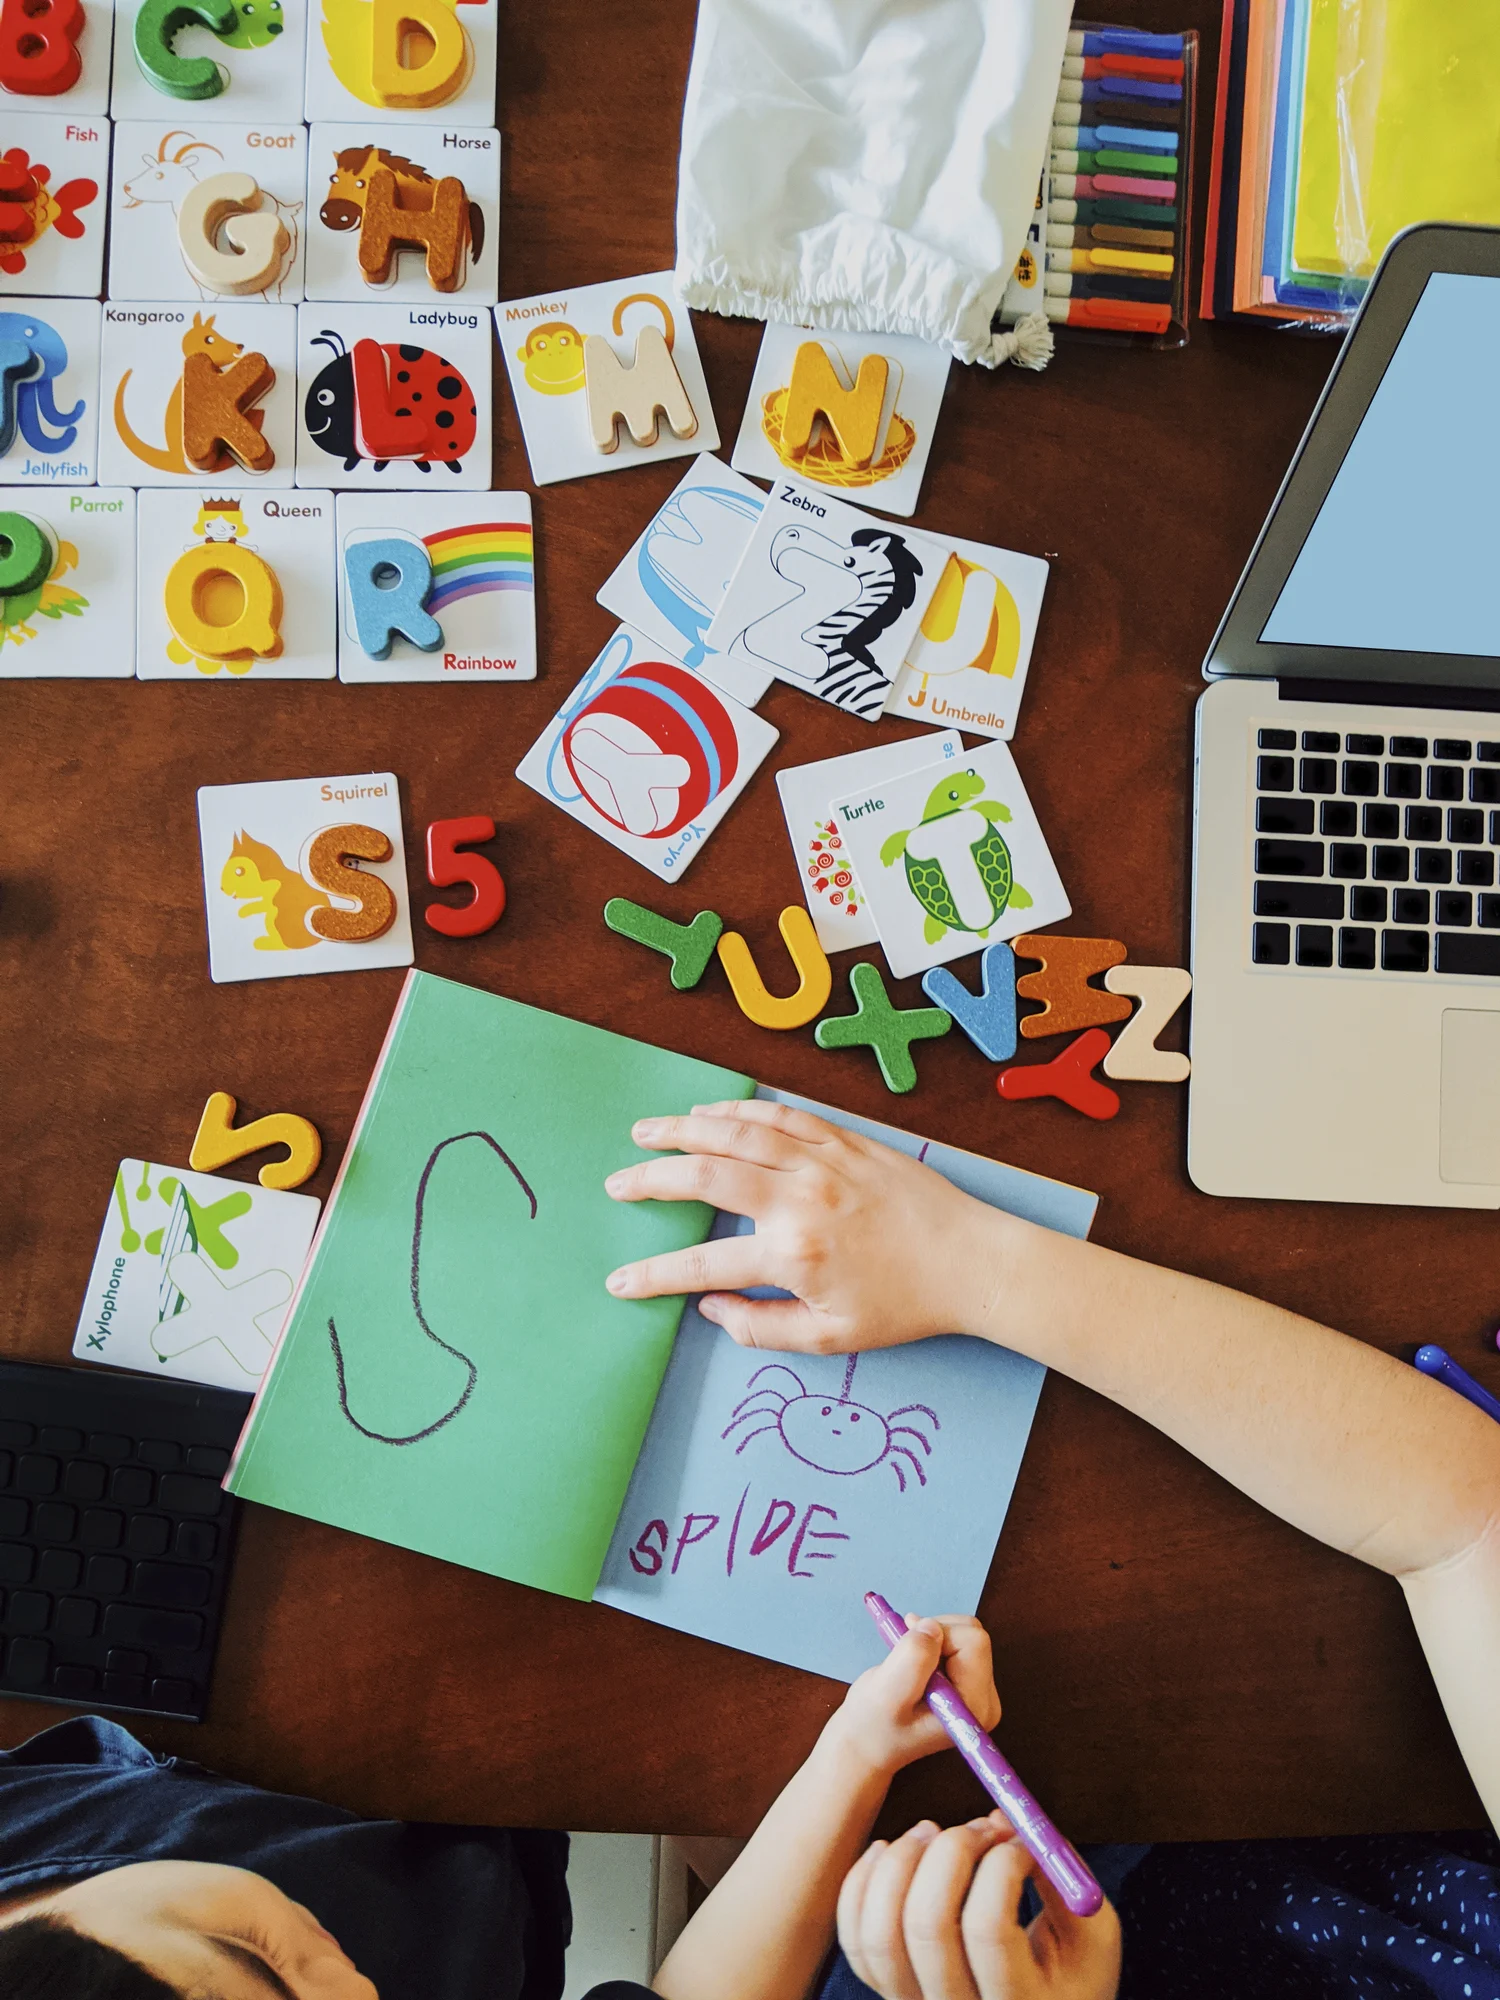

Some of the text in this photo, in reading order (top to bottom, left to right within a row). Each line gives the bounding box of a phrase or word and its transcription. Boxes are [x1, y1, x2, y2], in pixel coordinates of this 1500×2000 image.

[66, 126, 98, 142] Fish
[246, 132, 296, 149] Goat
[443, 132, 492, 150] Horse
[105, 309, 185, 326] Kangaroo
[409, 310, 478, 328] Ladybug
[505, 301, 569, 322] Monkey
[20, 459, 88, 479] Jellyfish
[69, 496, 124, 513] Parrot
[263, 500, 322, 517] Queen
[780, 485, 826, 519] Zebra
[444, 652, 517, 671] Rainbow
[931, 697, 1005, 729] Umbrella
[321, 783, 389, 803] Squirrel
[839, 798, 885, 822] Turtle
[663, 823, 706, 867] Yo-yo
[86, 1257, 126, 1352] Xylophone
[629, 1482, 850, 1578] SPIDE
